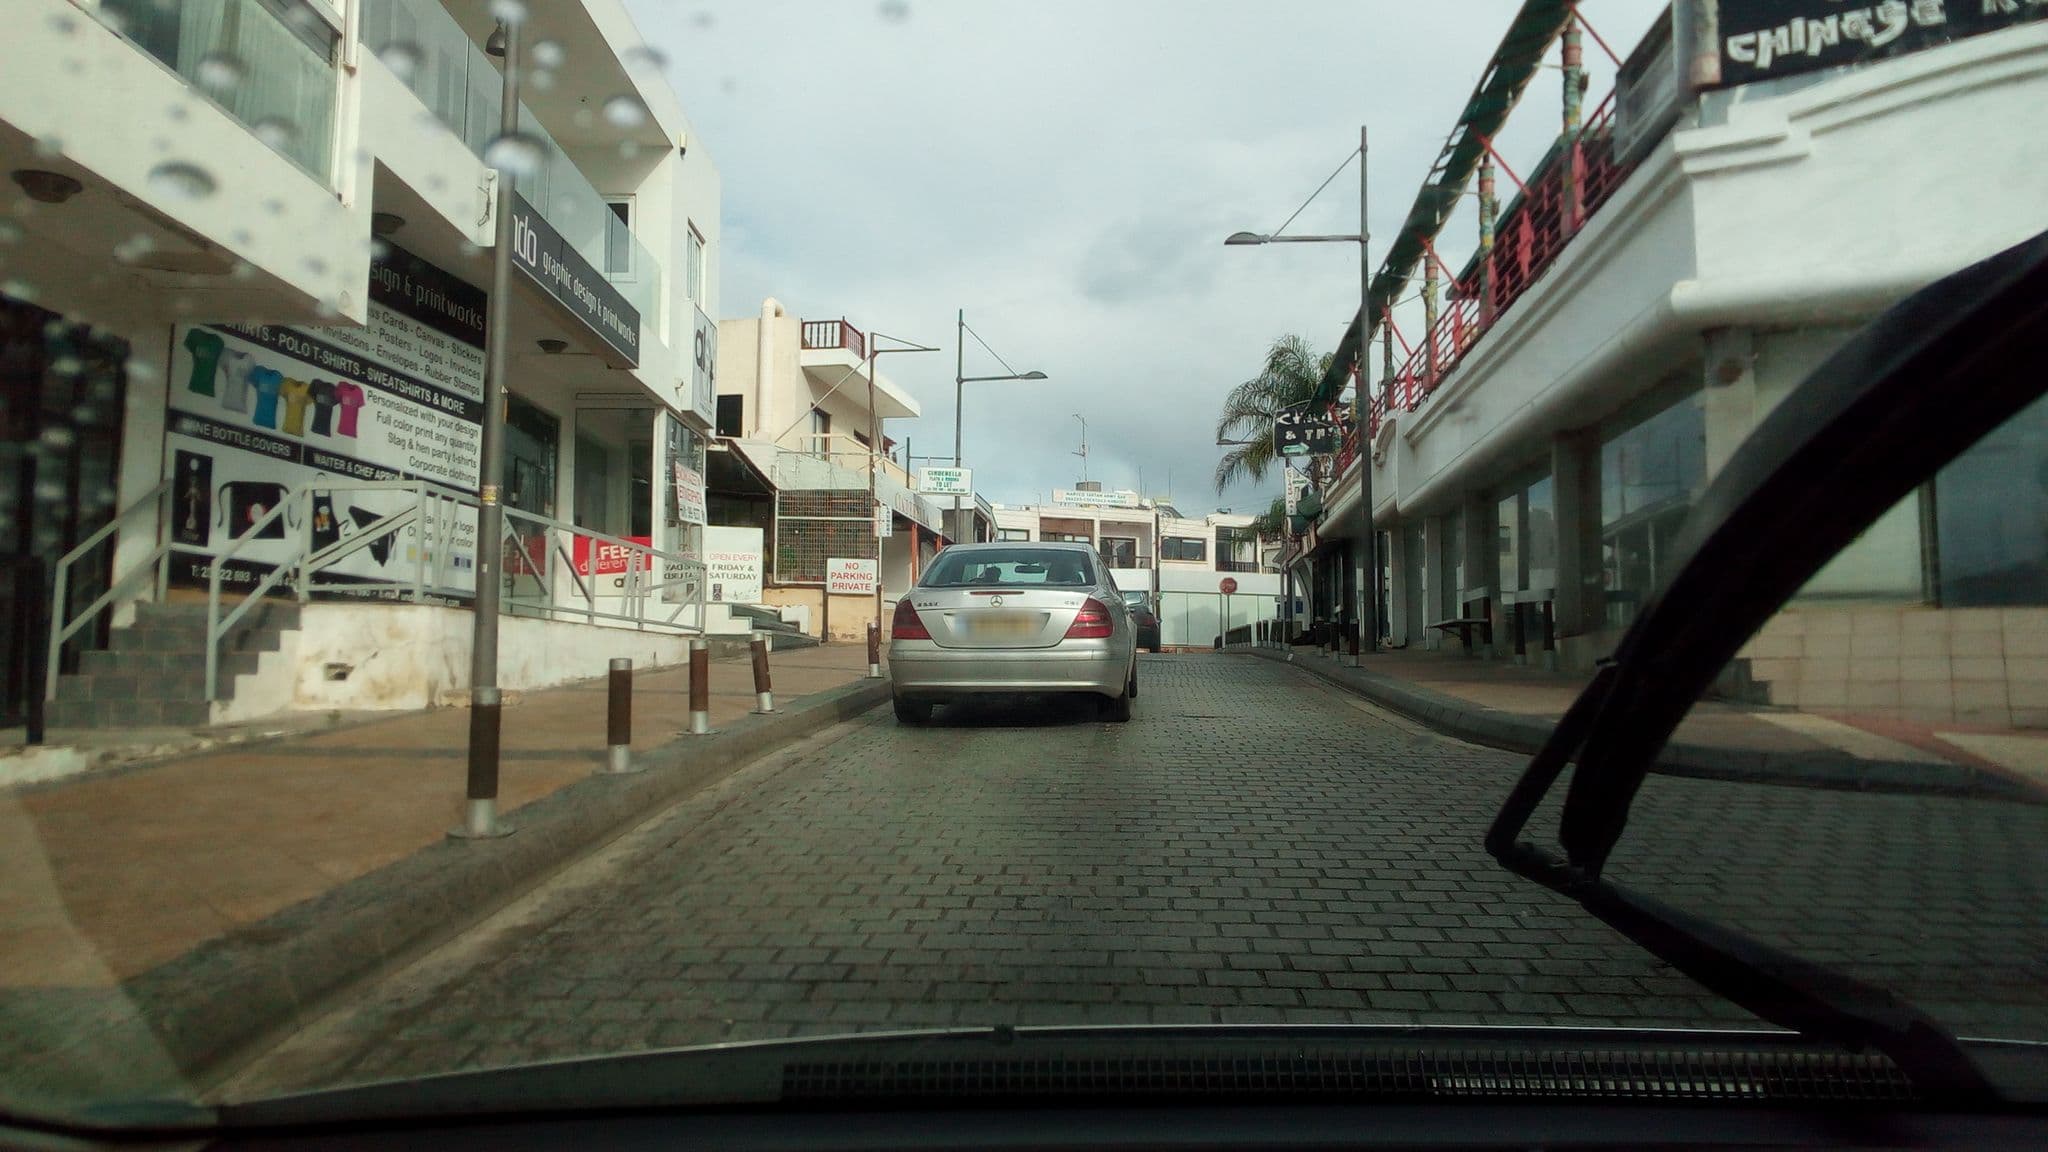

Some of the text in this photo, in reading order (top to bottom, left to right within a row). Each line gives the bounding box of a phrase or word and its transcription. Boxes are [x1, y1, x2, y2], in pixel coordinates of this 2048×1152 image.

[543, 251, 573, 290] graphic
[573, 278, 597, 314] design
[379, 327, 412, 352] Posters
[382, 311, 409, 333] Cards
[452, 342, 482, 365] Stickers
[377, 344, 419, 372] Envelopes
[279, 333, 311, 357] POLO
[312, 345, 361, 376] T-SHIRTS
[367, 366, 431, 403] SWEATSHIRTS
[433, 392, 440, 405] &
[440, 395, 466, 415] MORE
[367, 390, 479, 440] Personalized with your design
[212, 426, 251, 447] BOTTLE
[252, 436, 292, 457] COVERS
[376, 411, 478, 456] Full color print any quantity
[387, 431, 407, 451] Stag
[407, 437, 415, 451] &
[416, 439, 431, 456] hen
[431, 445, 452, 463] party
[313, 452, 345, 471] WAITER
[353, 464, 376, 479] CHEF
[408, 455, 477, 488] Corporate clothing
[709, 553, 758, 561] OPEN EVERY
[711, 563, 746, 572] FRIDAY
[844, 562, 860, 570] NO
[708, 572, 758, 581] SATURDAY
[830, 572, 873, 581] PARKING
[832, 582, 871, 591] PRIVATE
